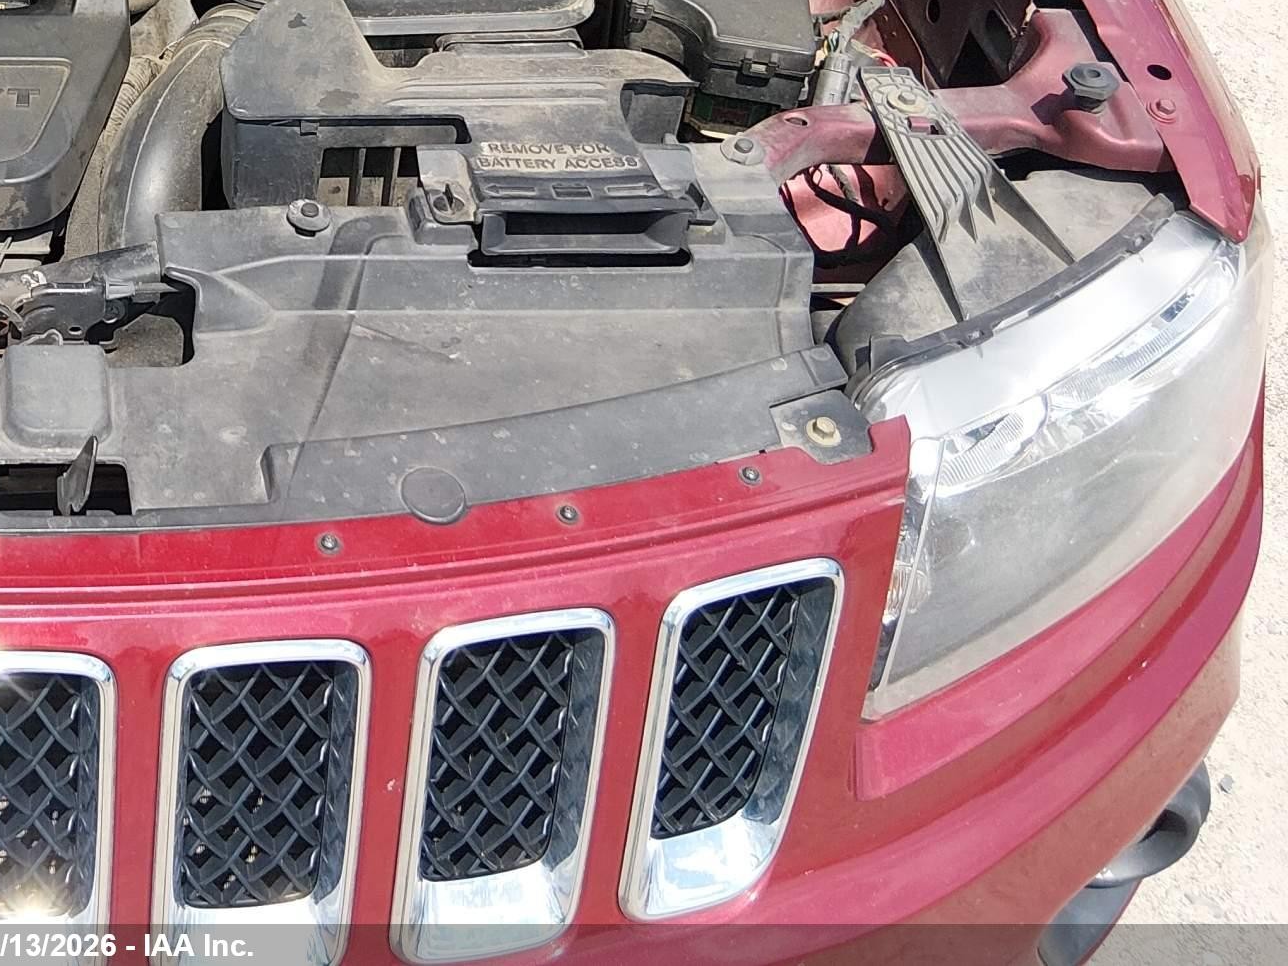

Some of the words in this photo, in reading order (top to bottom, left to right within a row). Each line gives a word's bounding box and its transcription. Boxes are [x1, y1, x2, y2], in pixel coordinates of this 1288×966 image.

[487, 142, 567, 155] REMOVE
[570, 143, 610, 155] FOR
[477, 156, 557, 169] BATTERY
[564, 156, 638, 170] ACCESS
